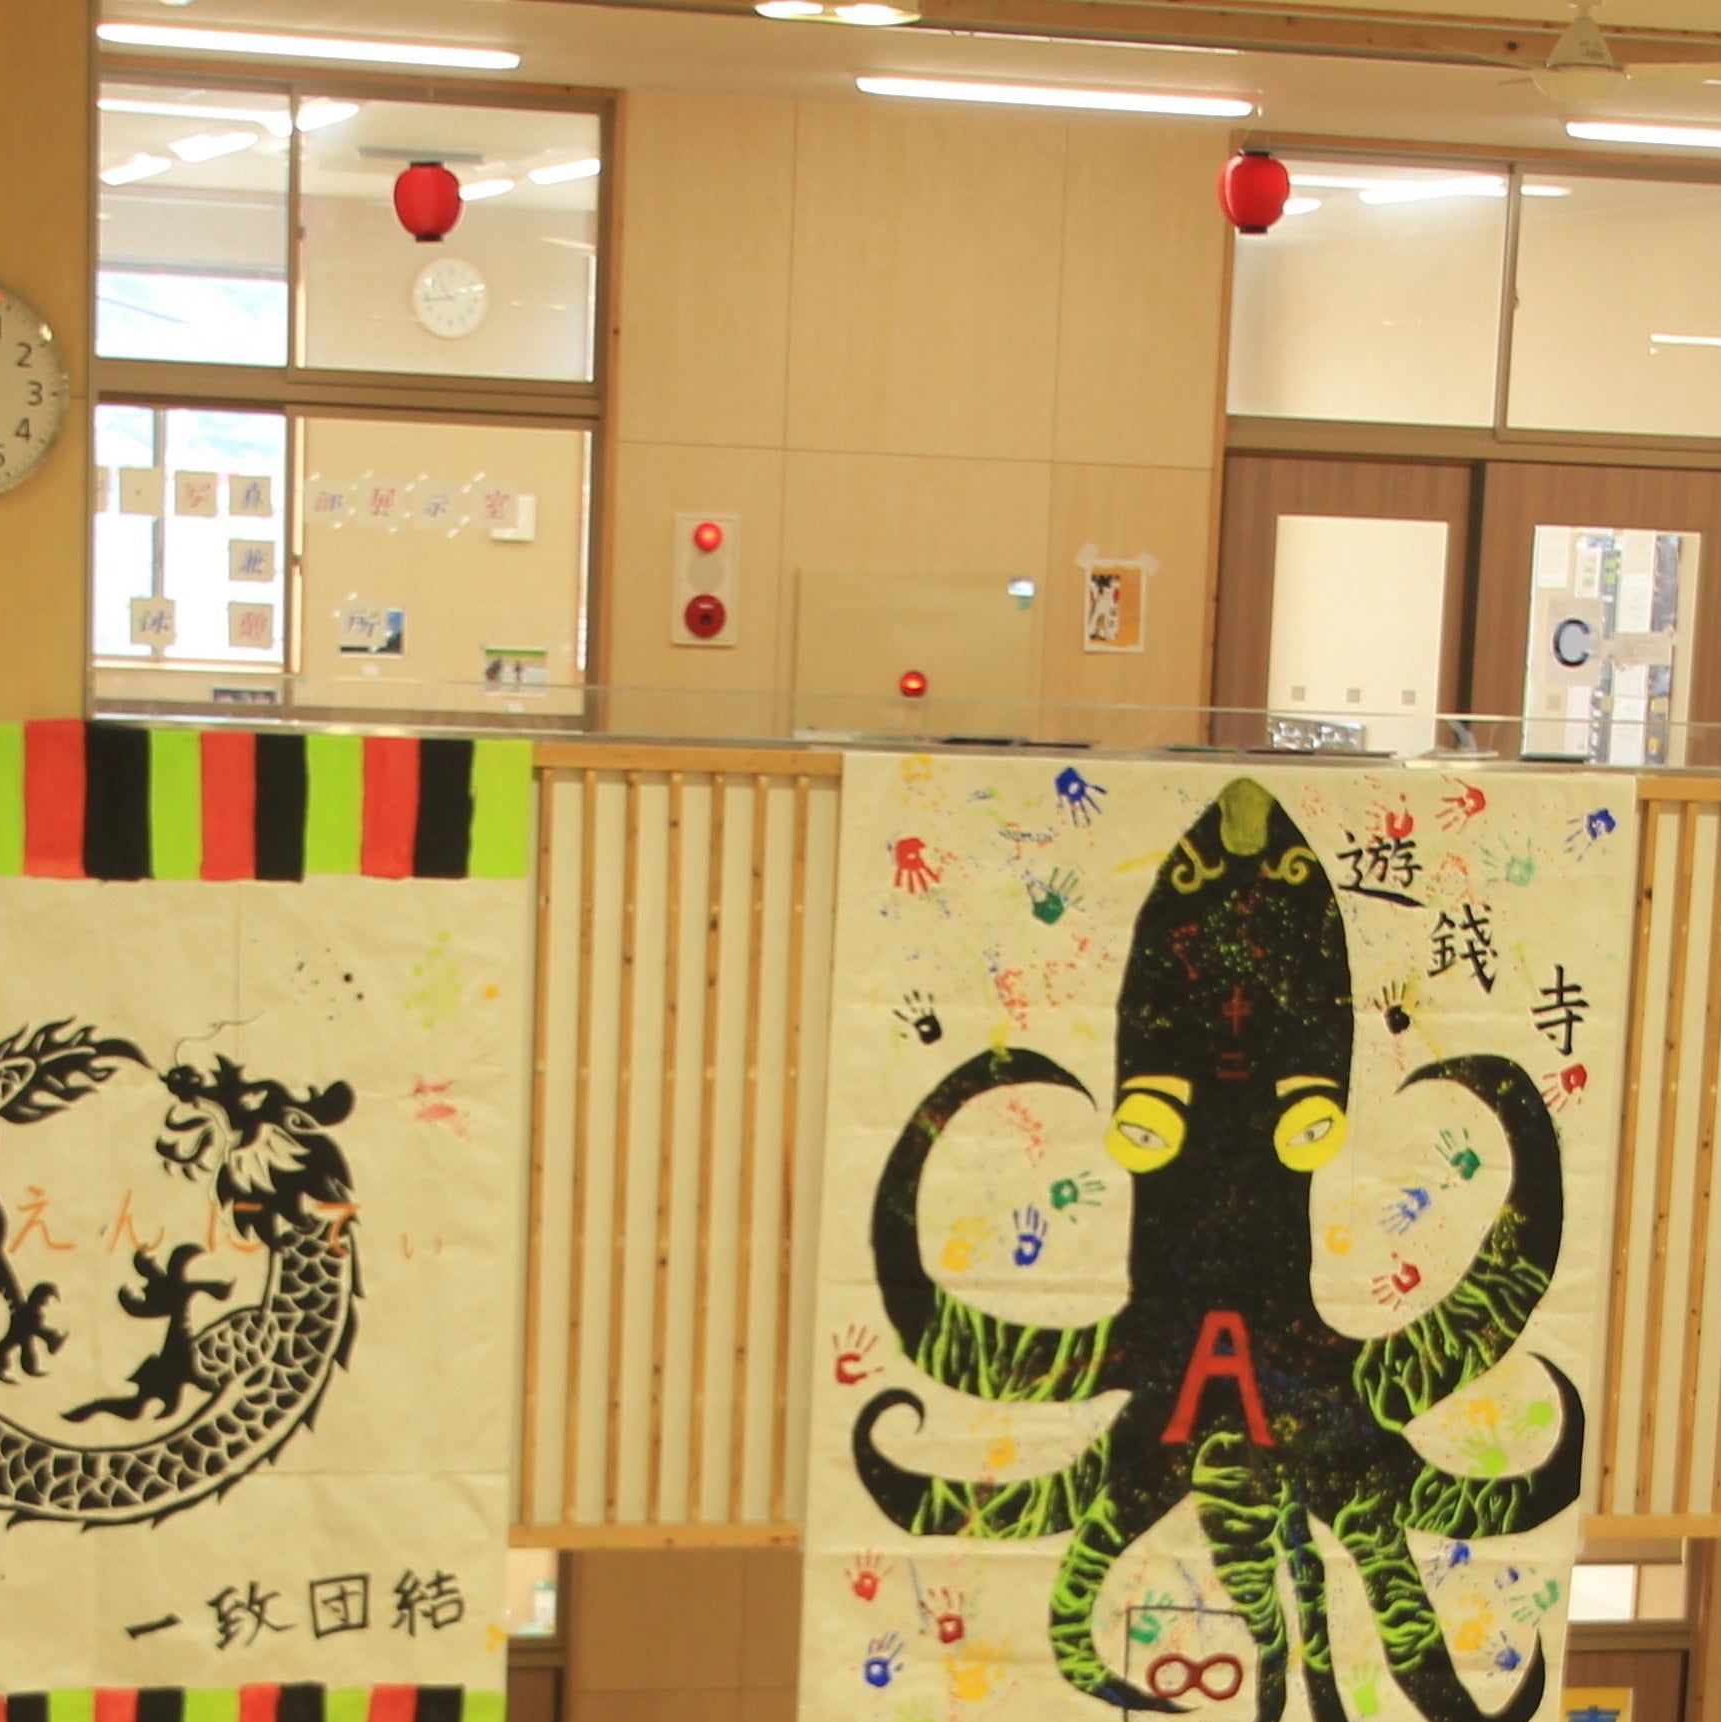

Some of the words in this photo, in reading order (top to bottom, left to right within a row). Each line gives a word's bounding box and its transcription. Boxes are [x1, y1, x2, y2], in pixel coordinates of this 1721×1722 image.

[16, 342, 32, 368] 2
[28, 380, 43, 406] 3
[15, 418, 32, 440] 4
[1552, 618, 1590, 667] C
[1162, 1310, 1275, 1446] A
[126, 1569, 466, 1651] 一致団結
